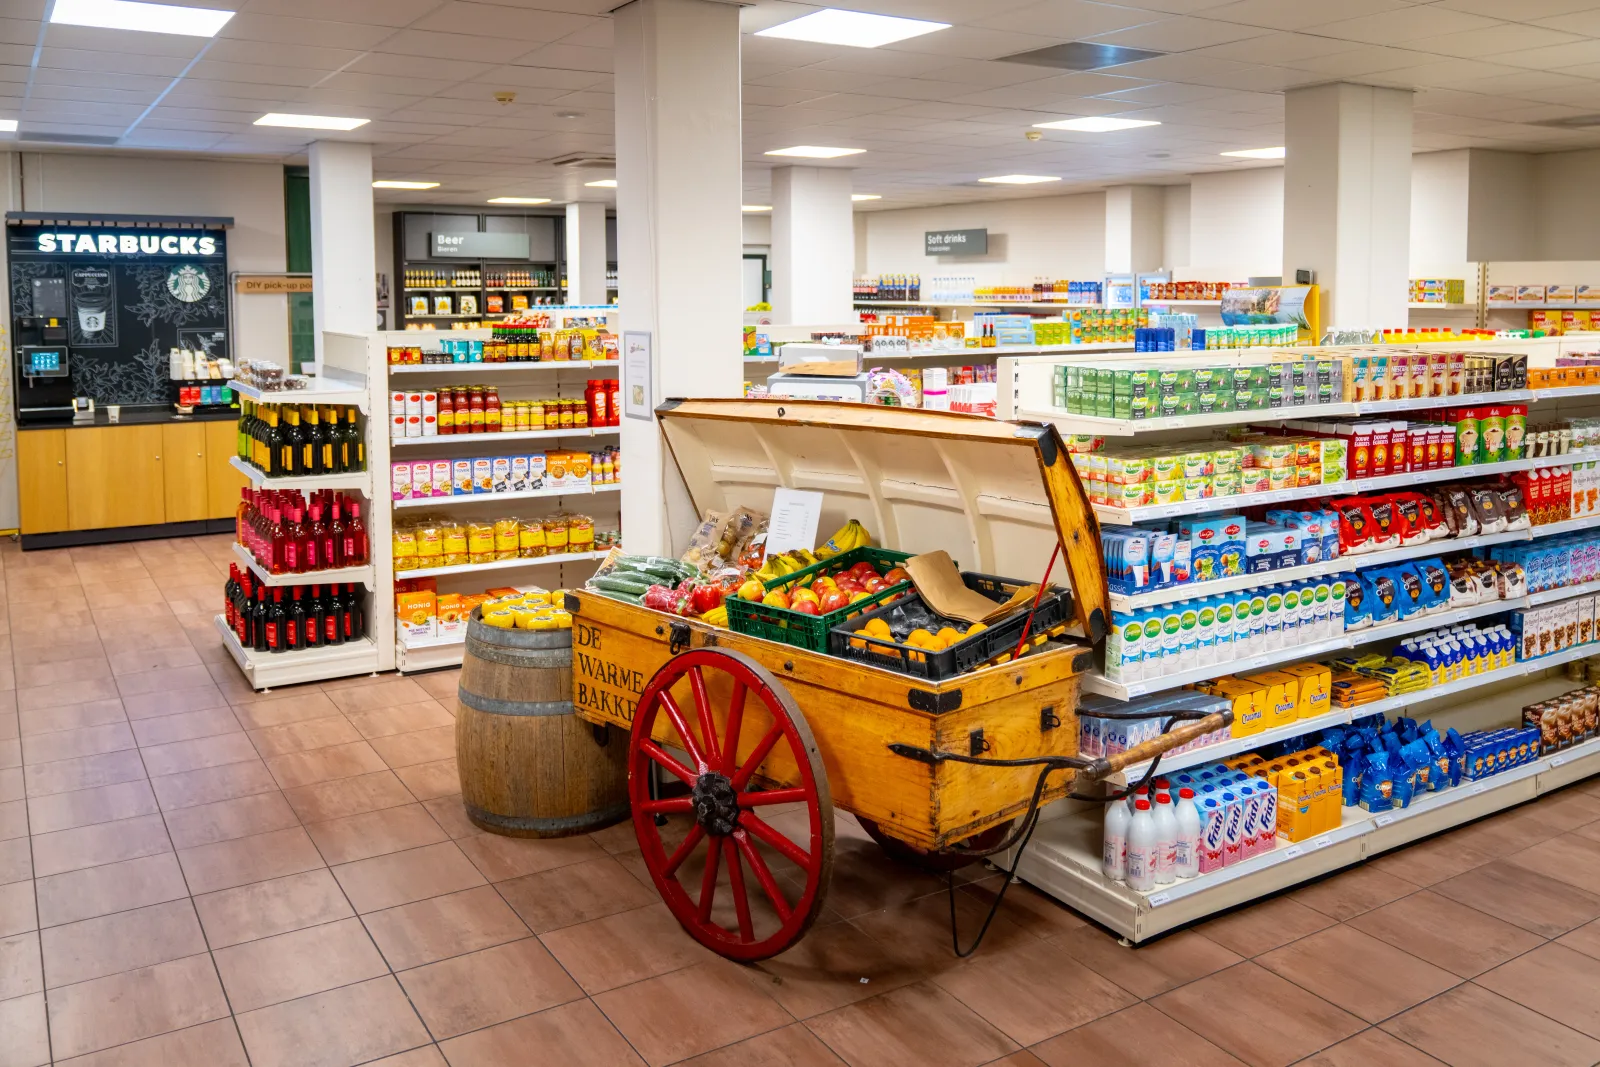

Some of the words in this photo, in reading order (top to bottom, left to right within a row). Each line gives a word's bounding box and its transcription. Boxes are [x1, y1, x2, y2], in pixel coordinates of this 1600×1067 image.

[38, 233, 216, 255] STARBUCKS
[437, 235, 464, 245] Beer
[928, 234, 943, 244] Soft
[944, 233, 966, 243] drinks
[246, 281, 261, 289] DIY
[264, 281, 297, 290] pick-up
[407, 602, 431, 610] HONIG
[578, 624, 601, 650] DE
[578, 652, 644, 694] WARME
[1226, 805, 1241, 843] Fristi
[1244, 798, 1259, 836] Fristi
[1260, 792, 1276, 830] Fristi
[1207, 810, 1224, 849] Fristi
